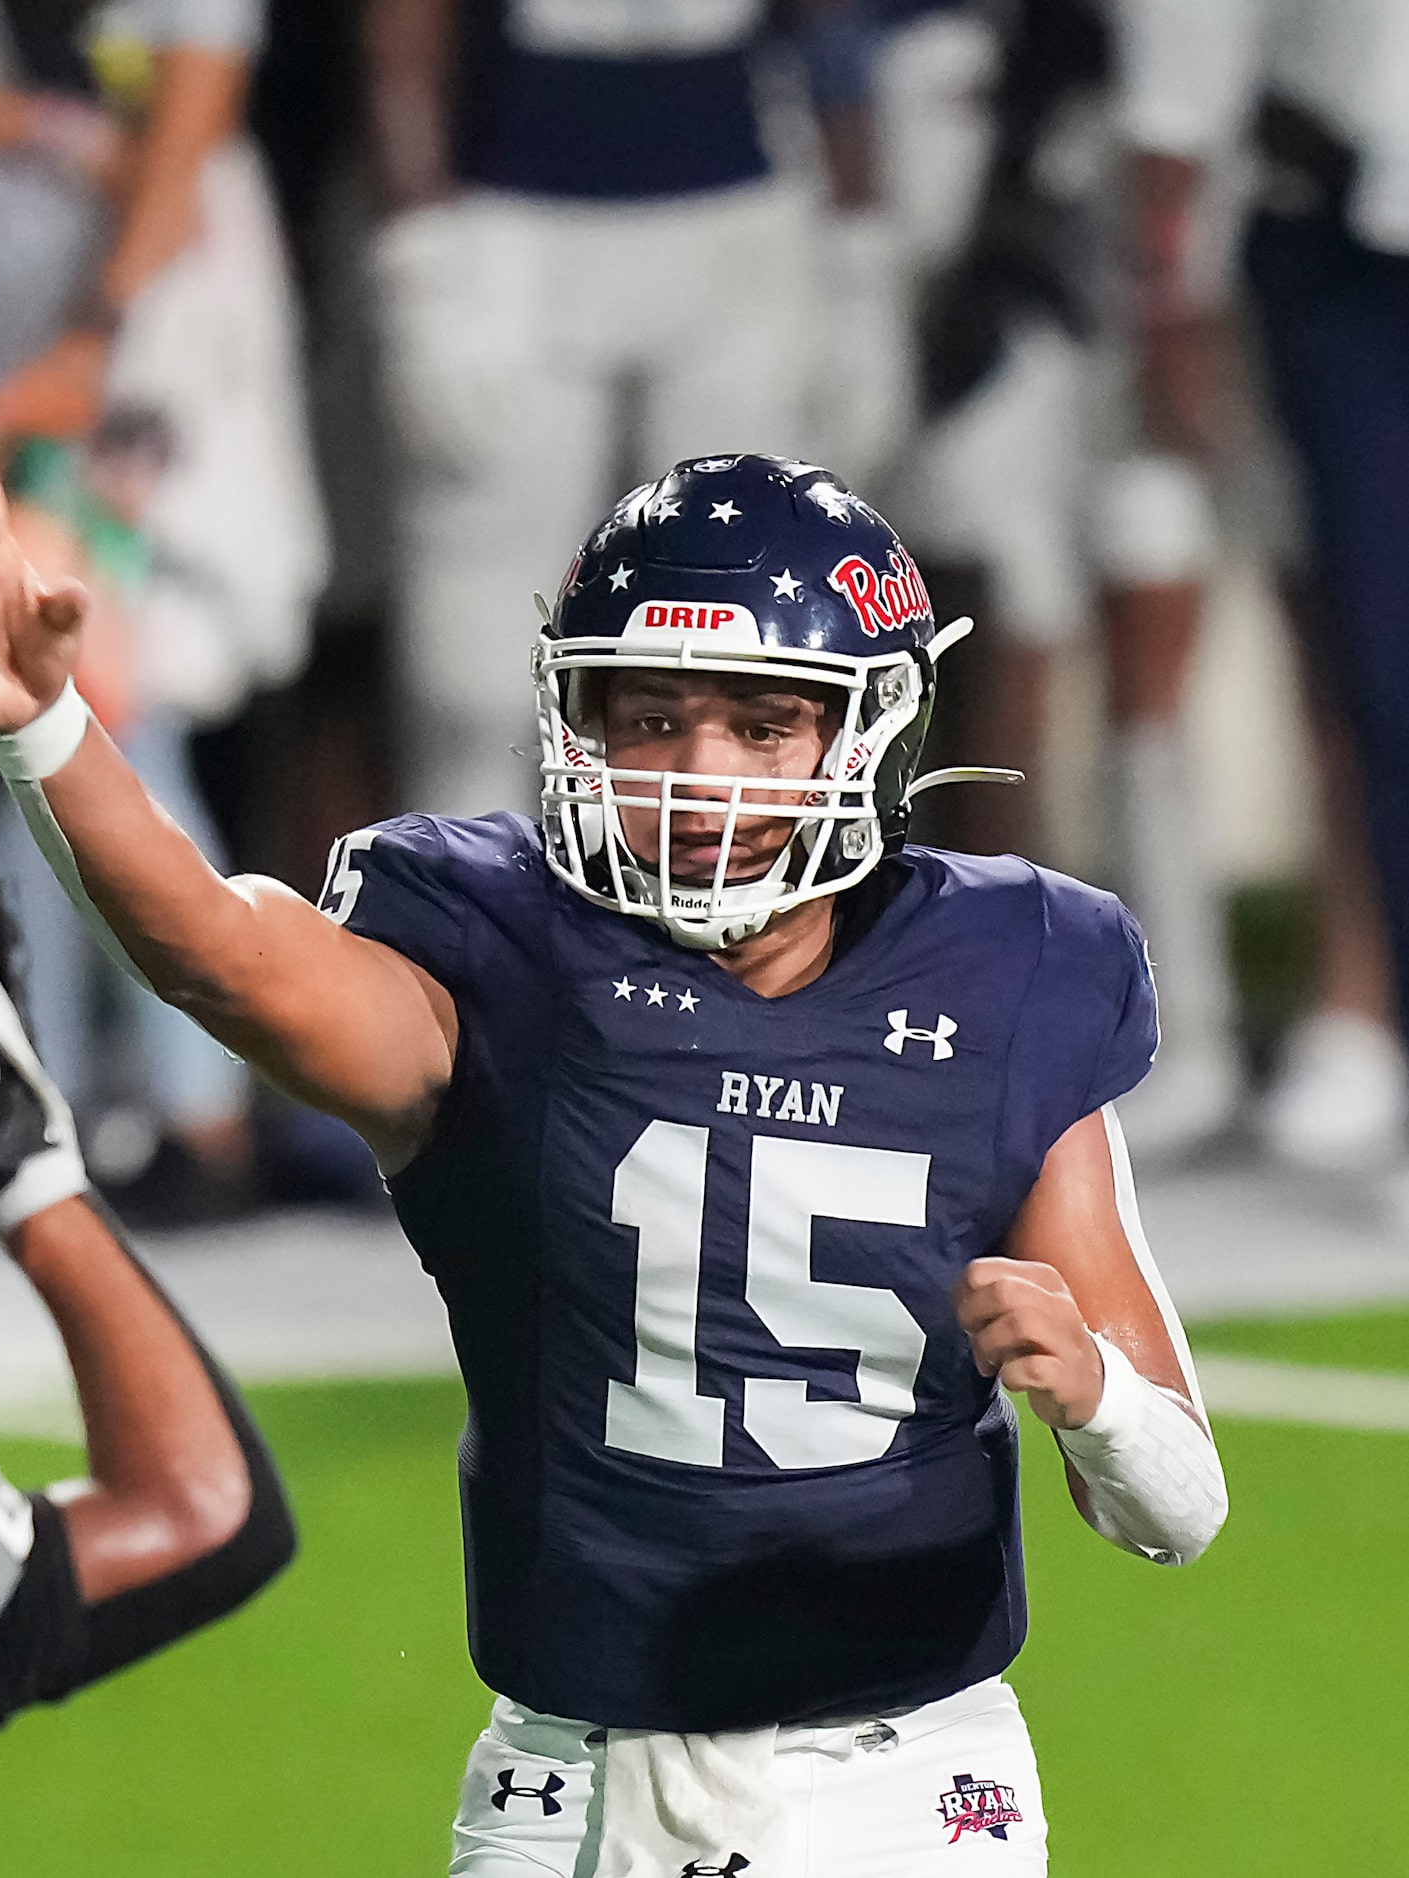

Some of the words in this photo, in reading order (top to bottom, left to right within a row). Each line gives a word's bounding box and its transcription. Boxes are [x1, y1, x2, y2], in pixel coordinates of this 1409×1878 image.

[645, 606, 735, 629] DRIP
[716, 1071, 844, 1126] RYAN
[604, 1119, 932, 1469] 15
[942, 1786, 1019, 1820] RYAN
